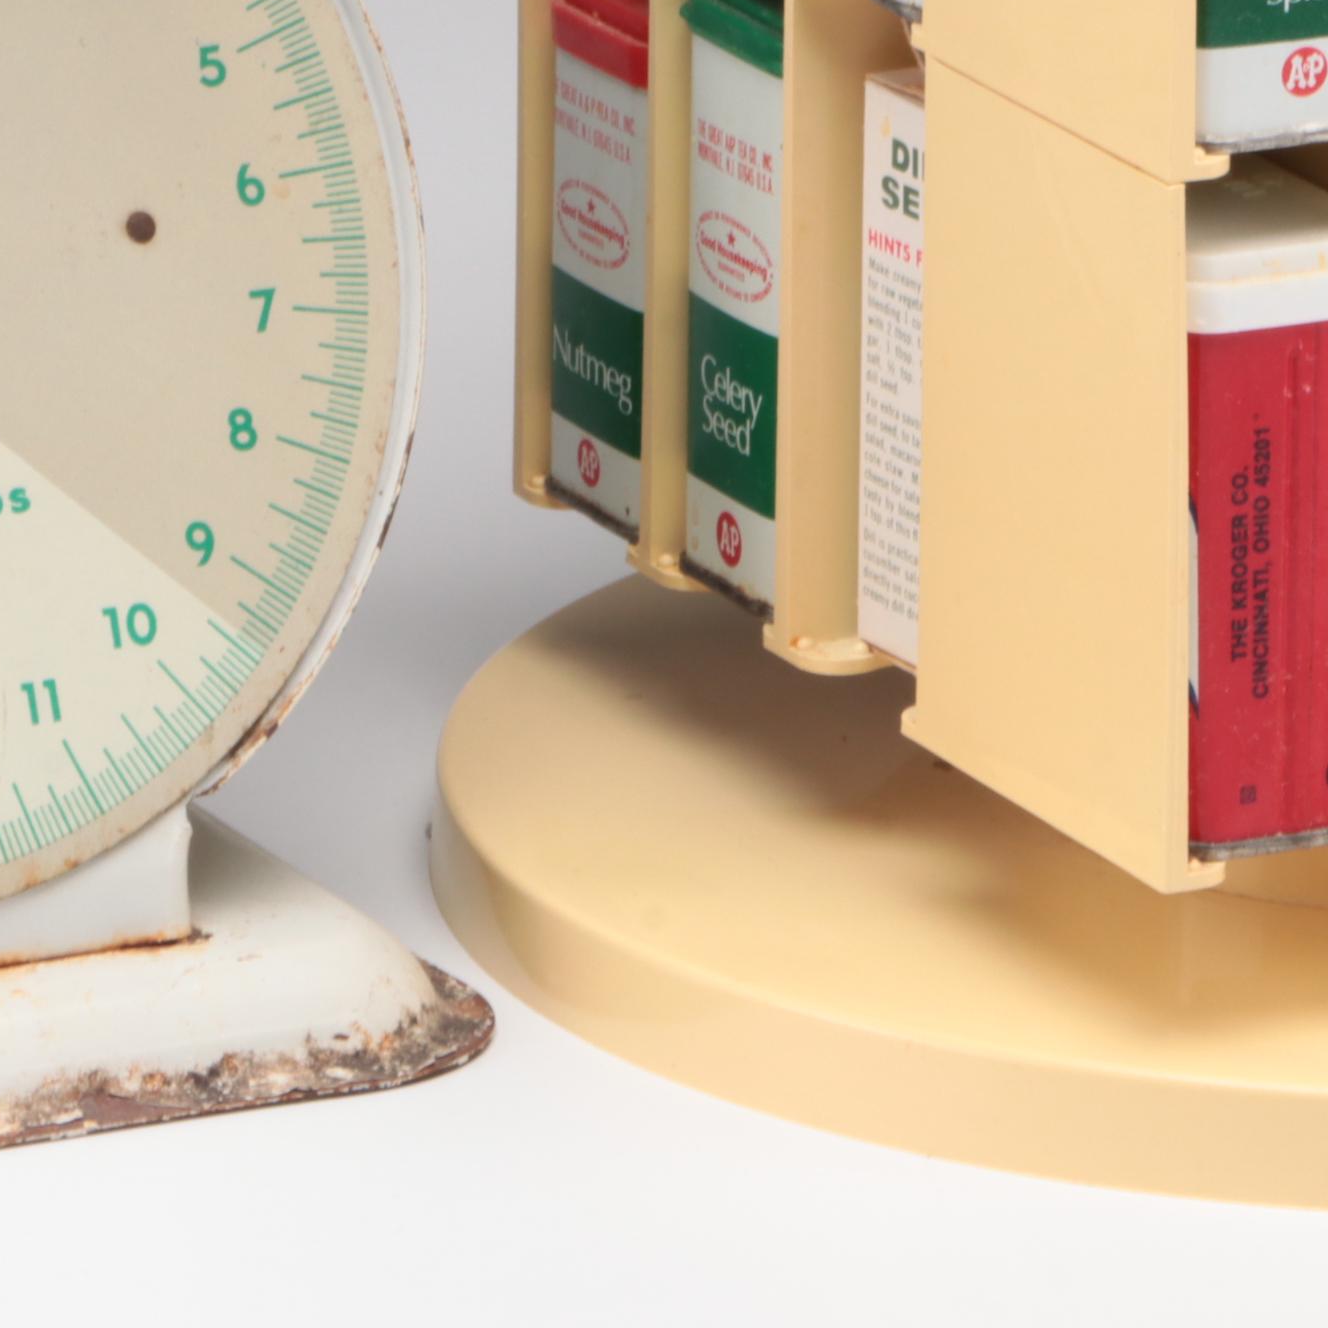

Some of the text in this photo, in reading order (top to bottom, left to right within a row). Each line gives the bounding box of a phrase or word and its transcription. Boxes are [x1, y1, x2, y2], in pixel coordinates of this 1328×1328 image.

[200, 45, 227, 87] 5
[237, 164, 266, 206] 6
[868, 228, 911, 263] HINTS
[249, 288, 275, 332] 7
[552, 324, 633, 417] Nutmeg
[701, 354, 762, 430] Celery
[228, 407, 257, 451] 8
[702, 394, 752, 457] Seed
[1253, 427, 1270, 487] 45201
[185, 521, 215, 566] 9
[1252, 496, 1270, 553] OHIO
[1231, 514, 1249, 610] KROGER
[102, 602, 158, 649] 10
[1231, 618, 1248, 662] THE
[20, 678, 62, 724] 11
